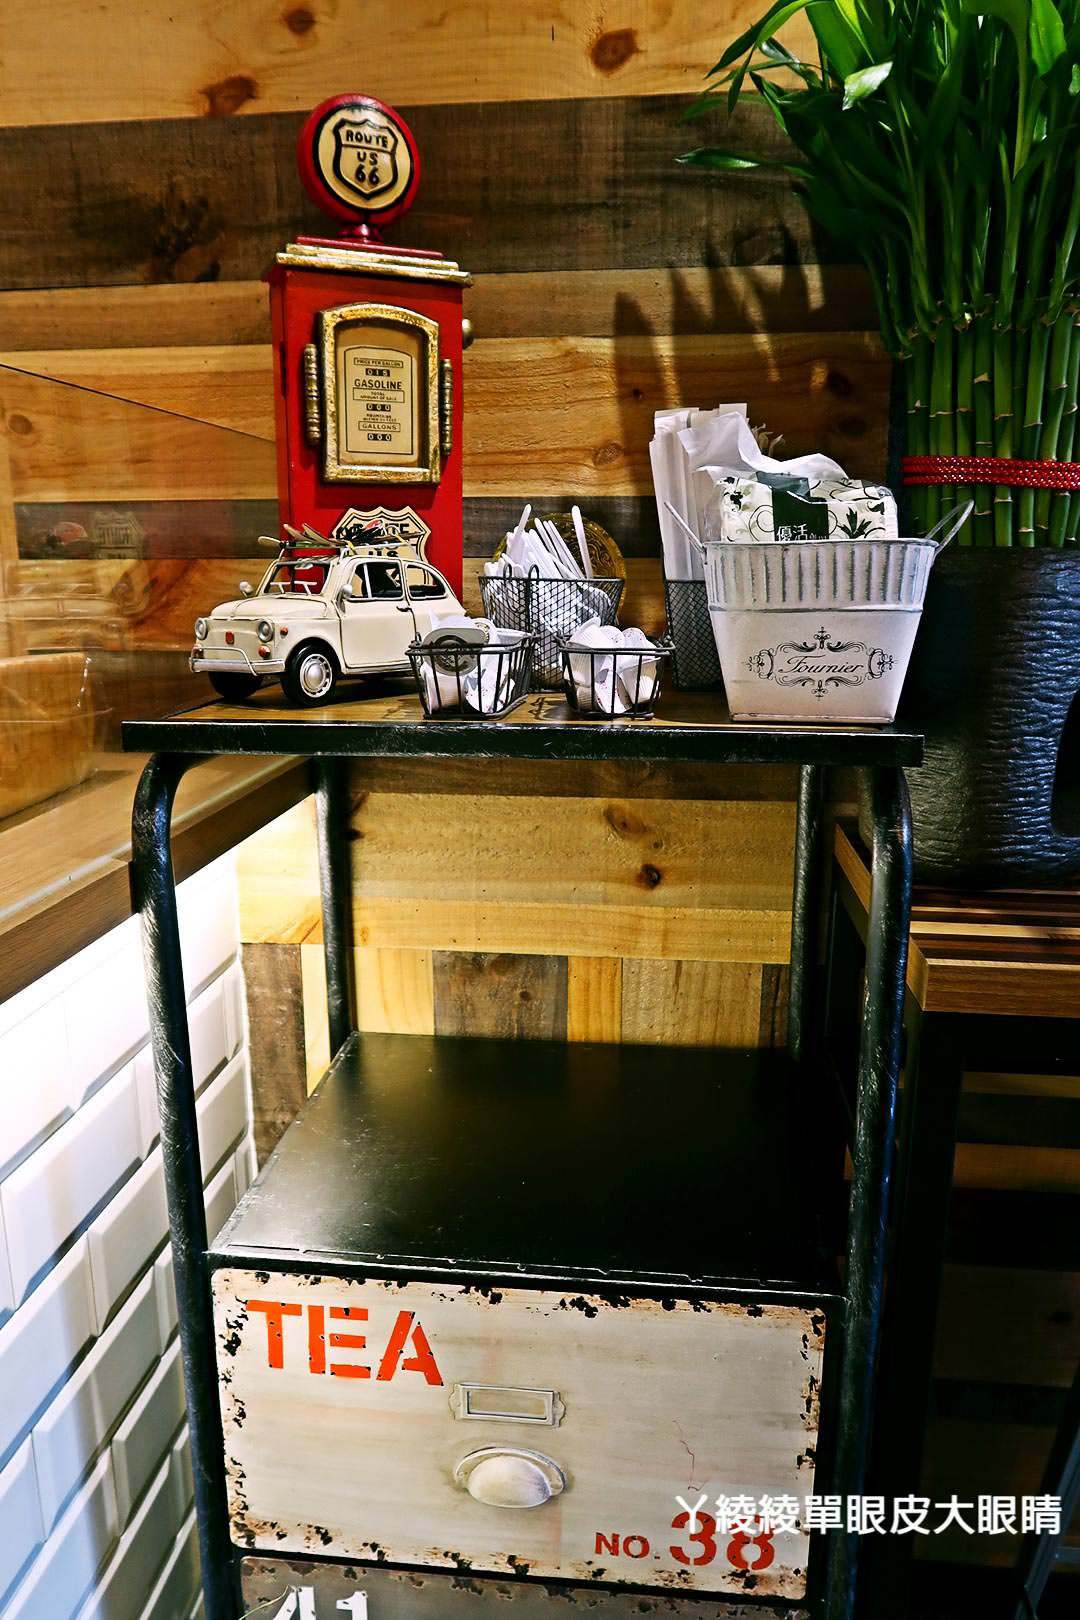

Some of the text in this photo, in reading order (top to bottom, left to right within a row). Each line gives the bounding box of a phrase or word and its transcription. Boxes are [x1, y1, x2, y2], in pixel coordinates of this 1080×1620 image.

[346, 130, 388, 148] ROUTE
[357, 151, 378, 165] US
[355, 164, 380, 185] 66
[354, 379, 402, 390] GASOLINE
[778, 654, 864, 674] Fournier
[246, 1299, 443, 1386] TEA
[669, 1511, 775, 1571] 38
